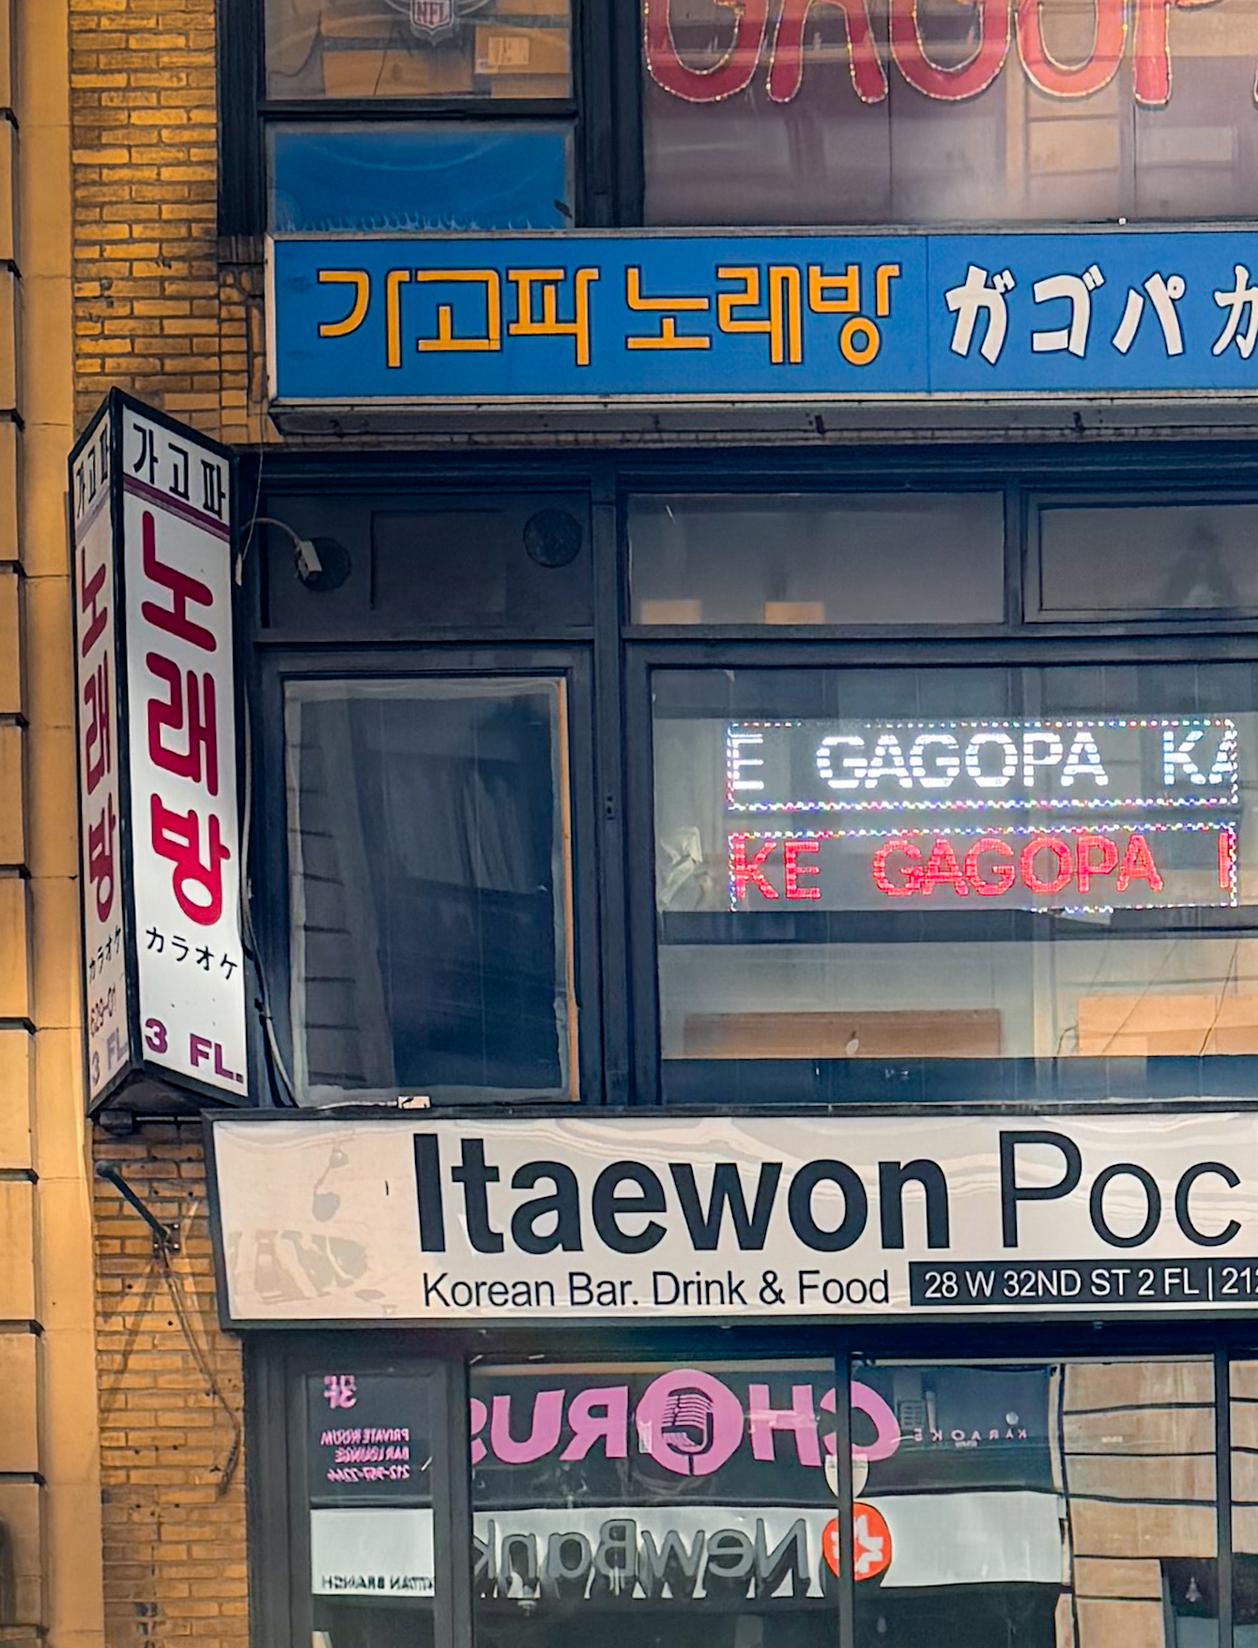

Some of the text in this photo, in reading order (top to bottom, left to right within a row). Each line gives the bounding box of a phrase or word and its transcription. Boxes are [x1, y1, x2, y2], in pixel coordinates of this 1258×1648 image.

[317, 264, 897, 370] 가고파 노래방
[944, 263, 1187, 366] ガゴパ
[132, 423, 226, 520] 가고파
[141, 510, 231, 926] 노래방
[815, 732, 1108, 788] GAGOPA
[872, 834, 1163, 897] GAGOPA
[145, 926, 239, 980] カラオケ
[144, 1017, 168, 1054] 3
[412, 1132, 950, 1255] Itaewon
[423, 1272, 555, 1307] Korean
[568, 1271, 640, 1307] Bar.
[653, 1271, 743, 1306] Drink
[761, 1271, 786, 1306] &
[798, 1269, 890, 1305] Food
[924, 1271, 959, 1297] 28
[967, 1271, 998, 1297] W
[1003, 1270, 1081, 1297] 32ND
[1088, 1269, 1134, 1296] ST
[1140, 1269, 1156, 1295] 2
[1162, 1268, 1200, 1295] FL
